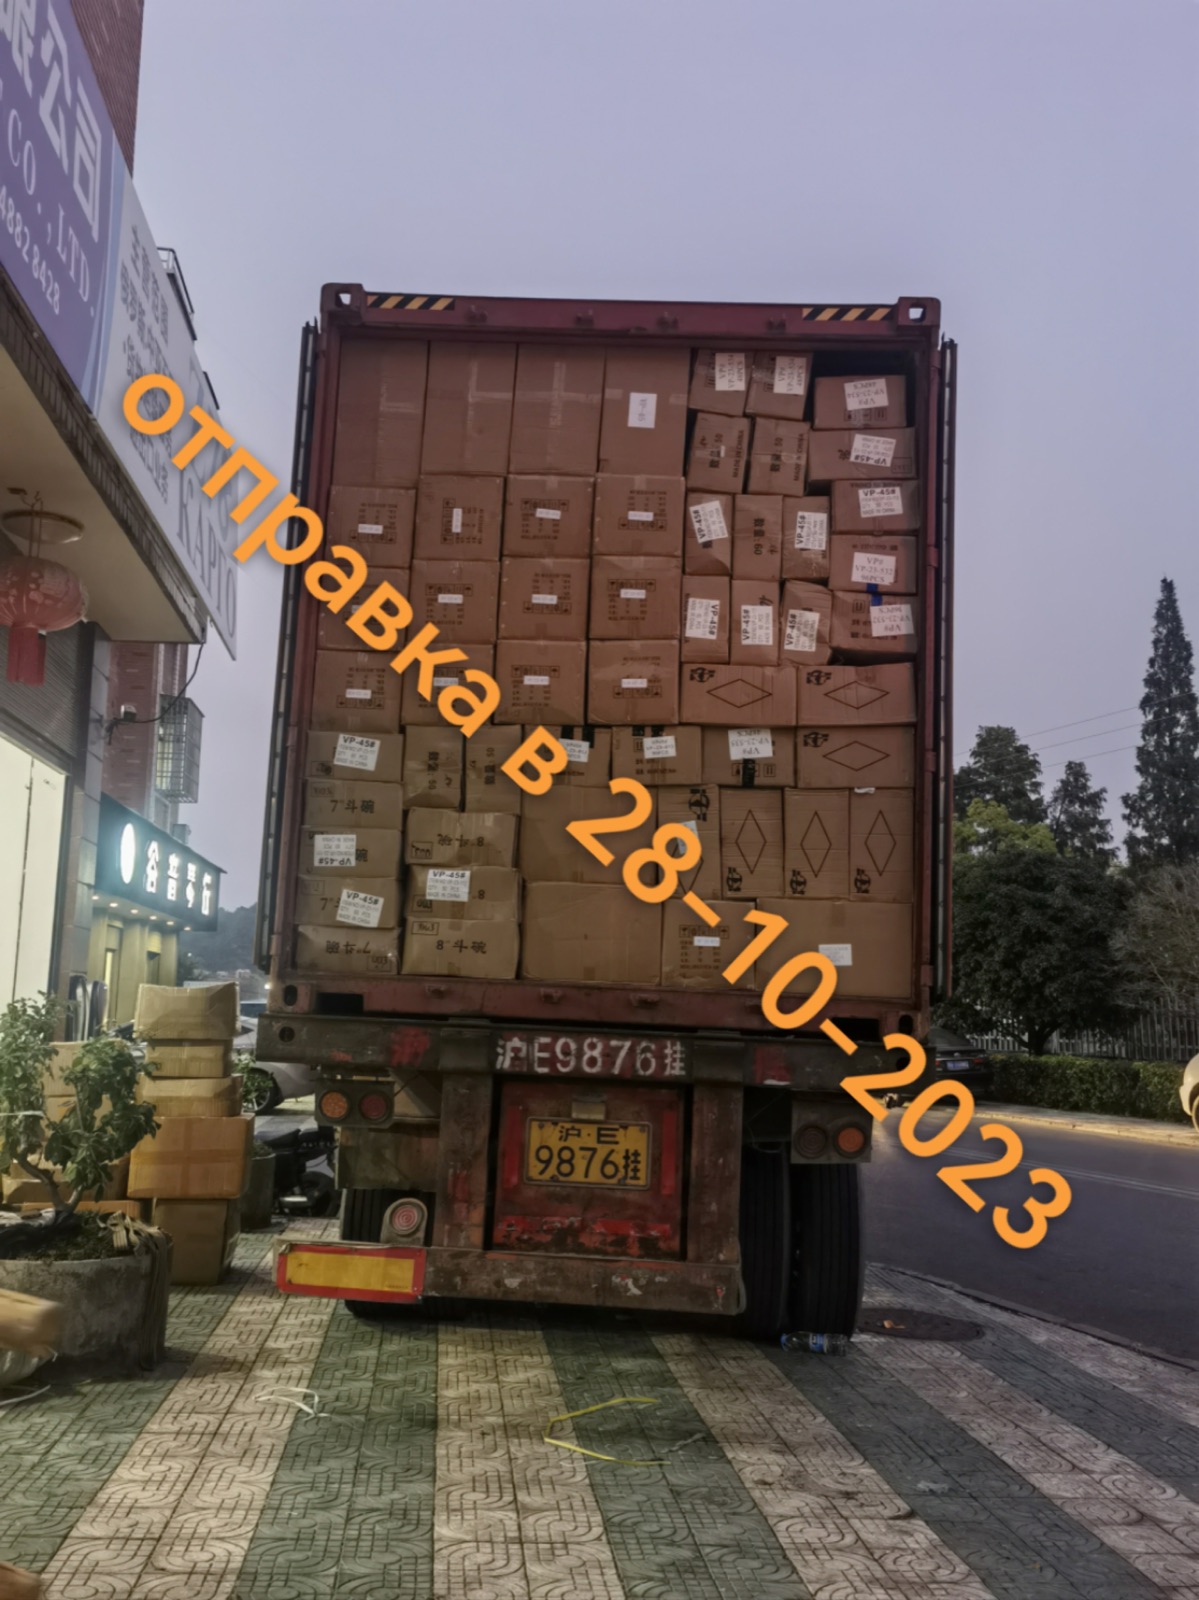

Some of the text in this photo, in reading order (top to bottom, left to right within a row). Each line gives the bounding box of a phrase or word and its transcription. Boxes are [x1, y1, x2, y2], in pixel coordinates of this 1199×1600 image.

[854, 454, 888, 466] VP-45#
[863, 489, 897, 497] VP-45#
[692, 509, 706, 540] VP-45#
[796, 514, 806, 545] VP-45#
[708, 604, 719, 636] VP-45#
[742, 608, 750, 641] VP-45#
[786, 613, 797, 646] VP-45#
[343, 735, 376, 748] VP-45#
[318, 858, 352, 866] VP-45#
[432, 870, 466, 879] VP-45#
[346, 891, 379, 905] VP-45#
[495, 1036, 687, 1077] 沪E9876挂
[535, 1144, 642, 1182] 9876挂
